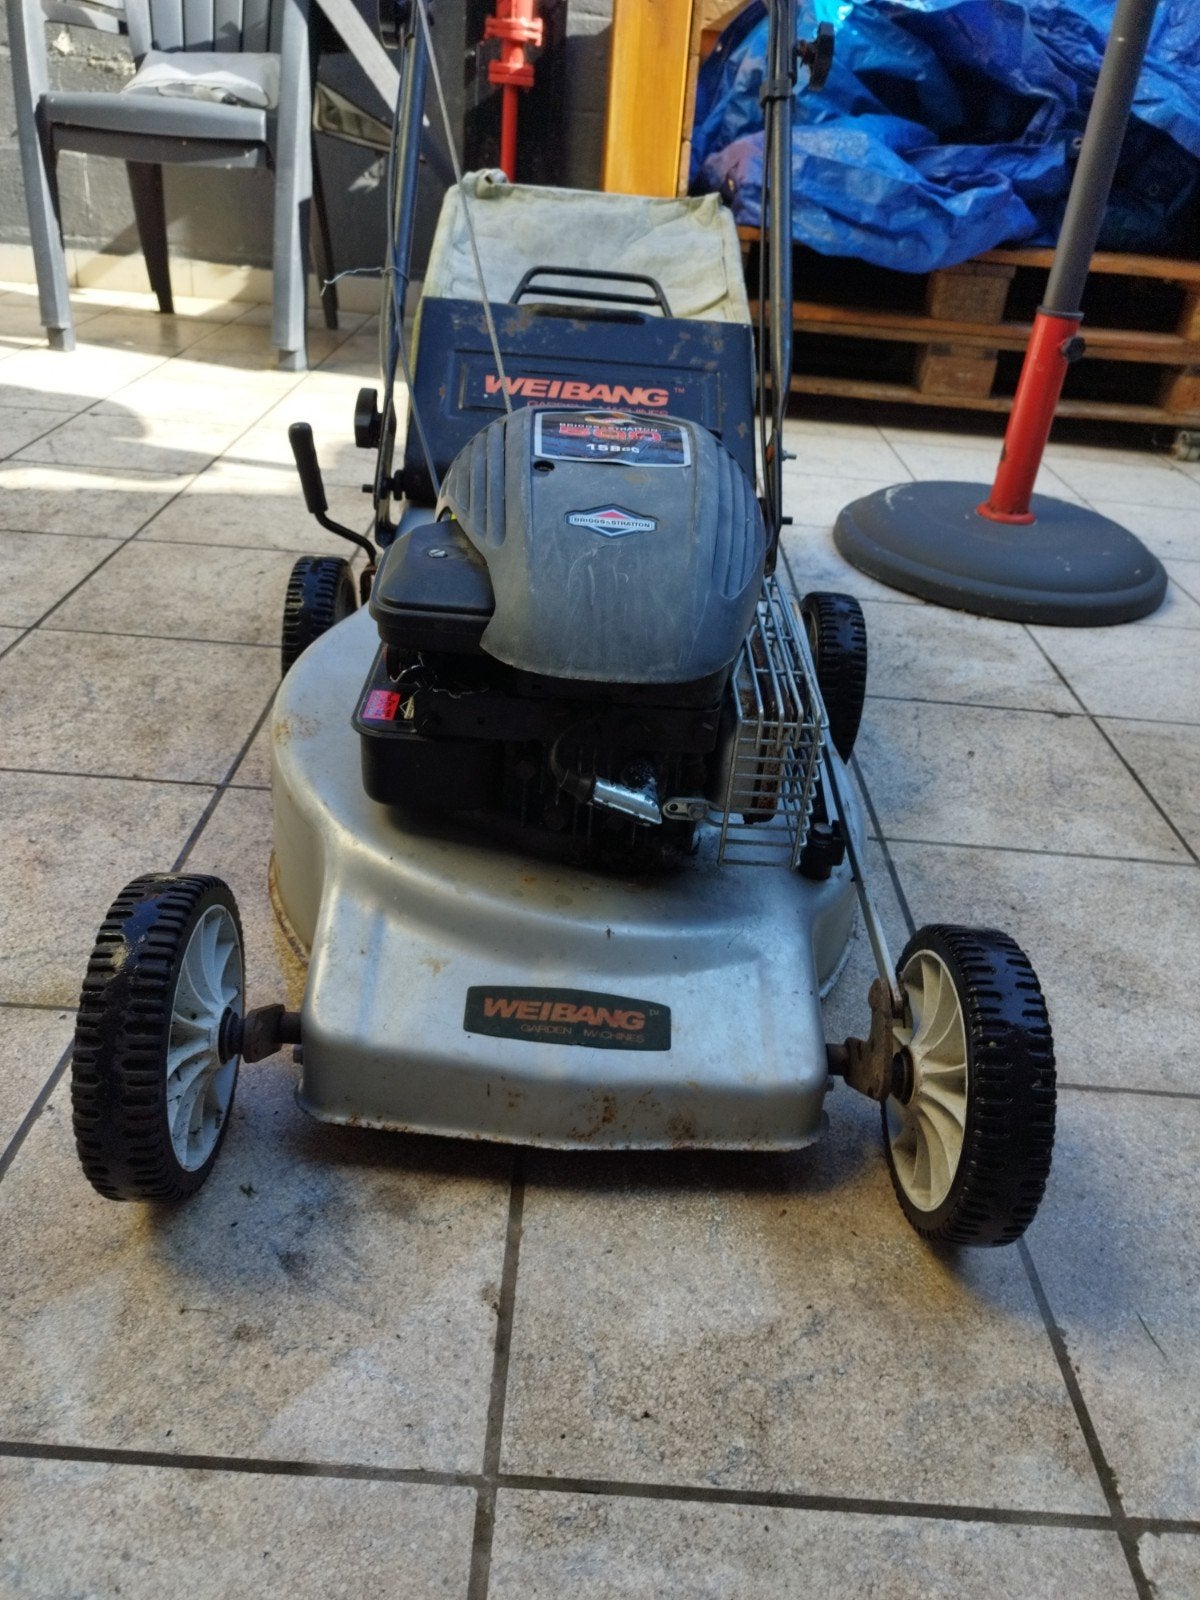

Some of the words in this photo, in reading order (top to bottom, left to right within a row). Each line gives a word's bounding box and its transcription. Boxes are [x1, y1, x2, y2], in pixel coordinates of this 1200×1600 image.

[484, 375, 669, 407] WEIBANG
[482, 997, 646, 1030] WEIBANG
[520, 1023, 573, 1035] GARDEN
[583, 1028, 645, 1044] MACHINES
